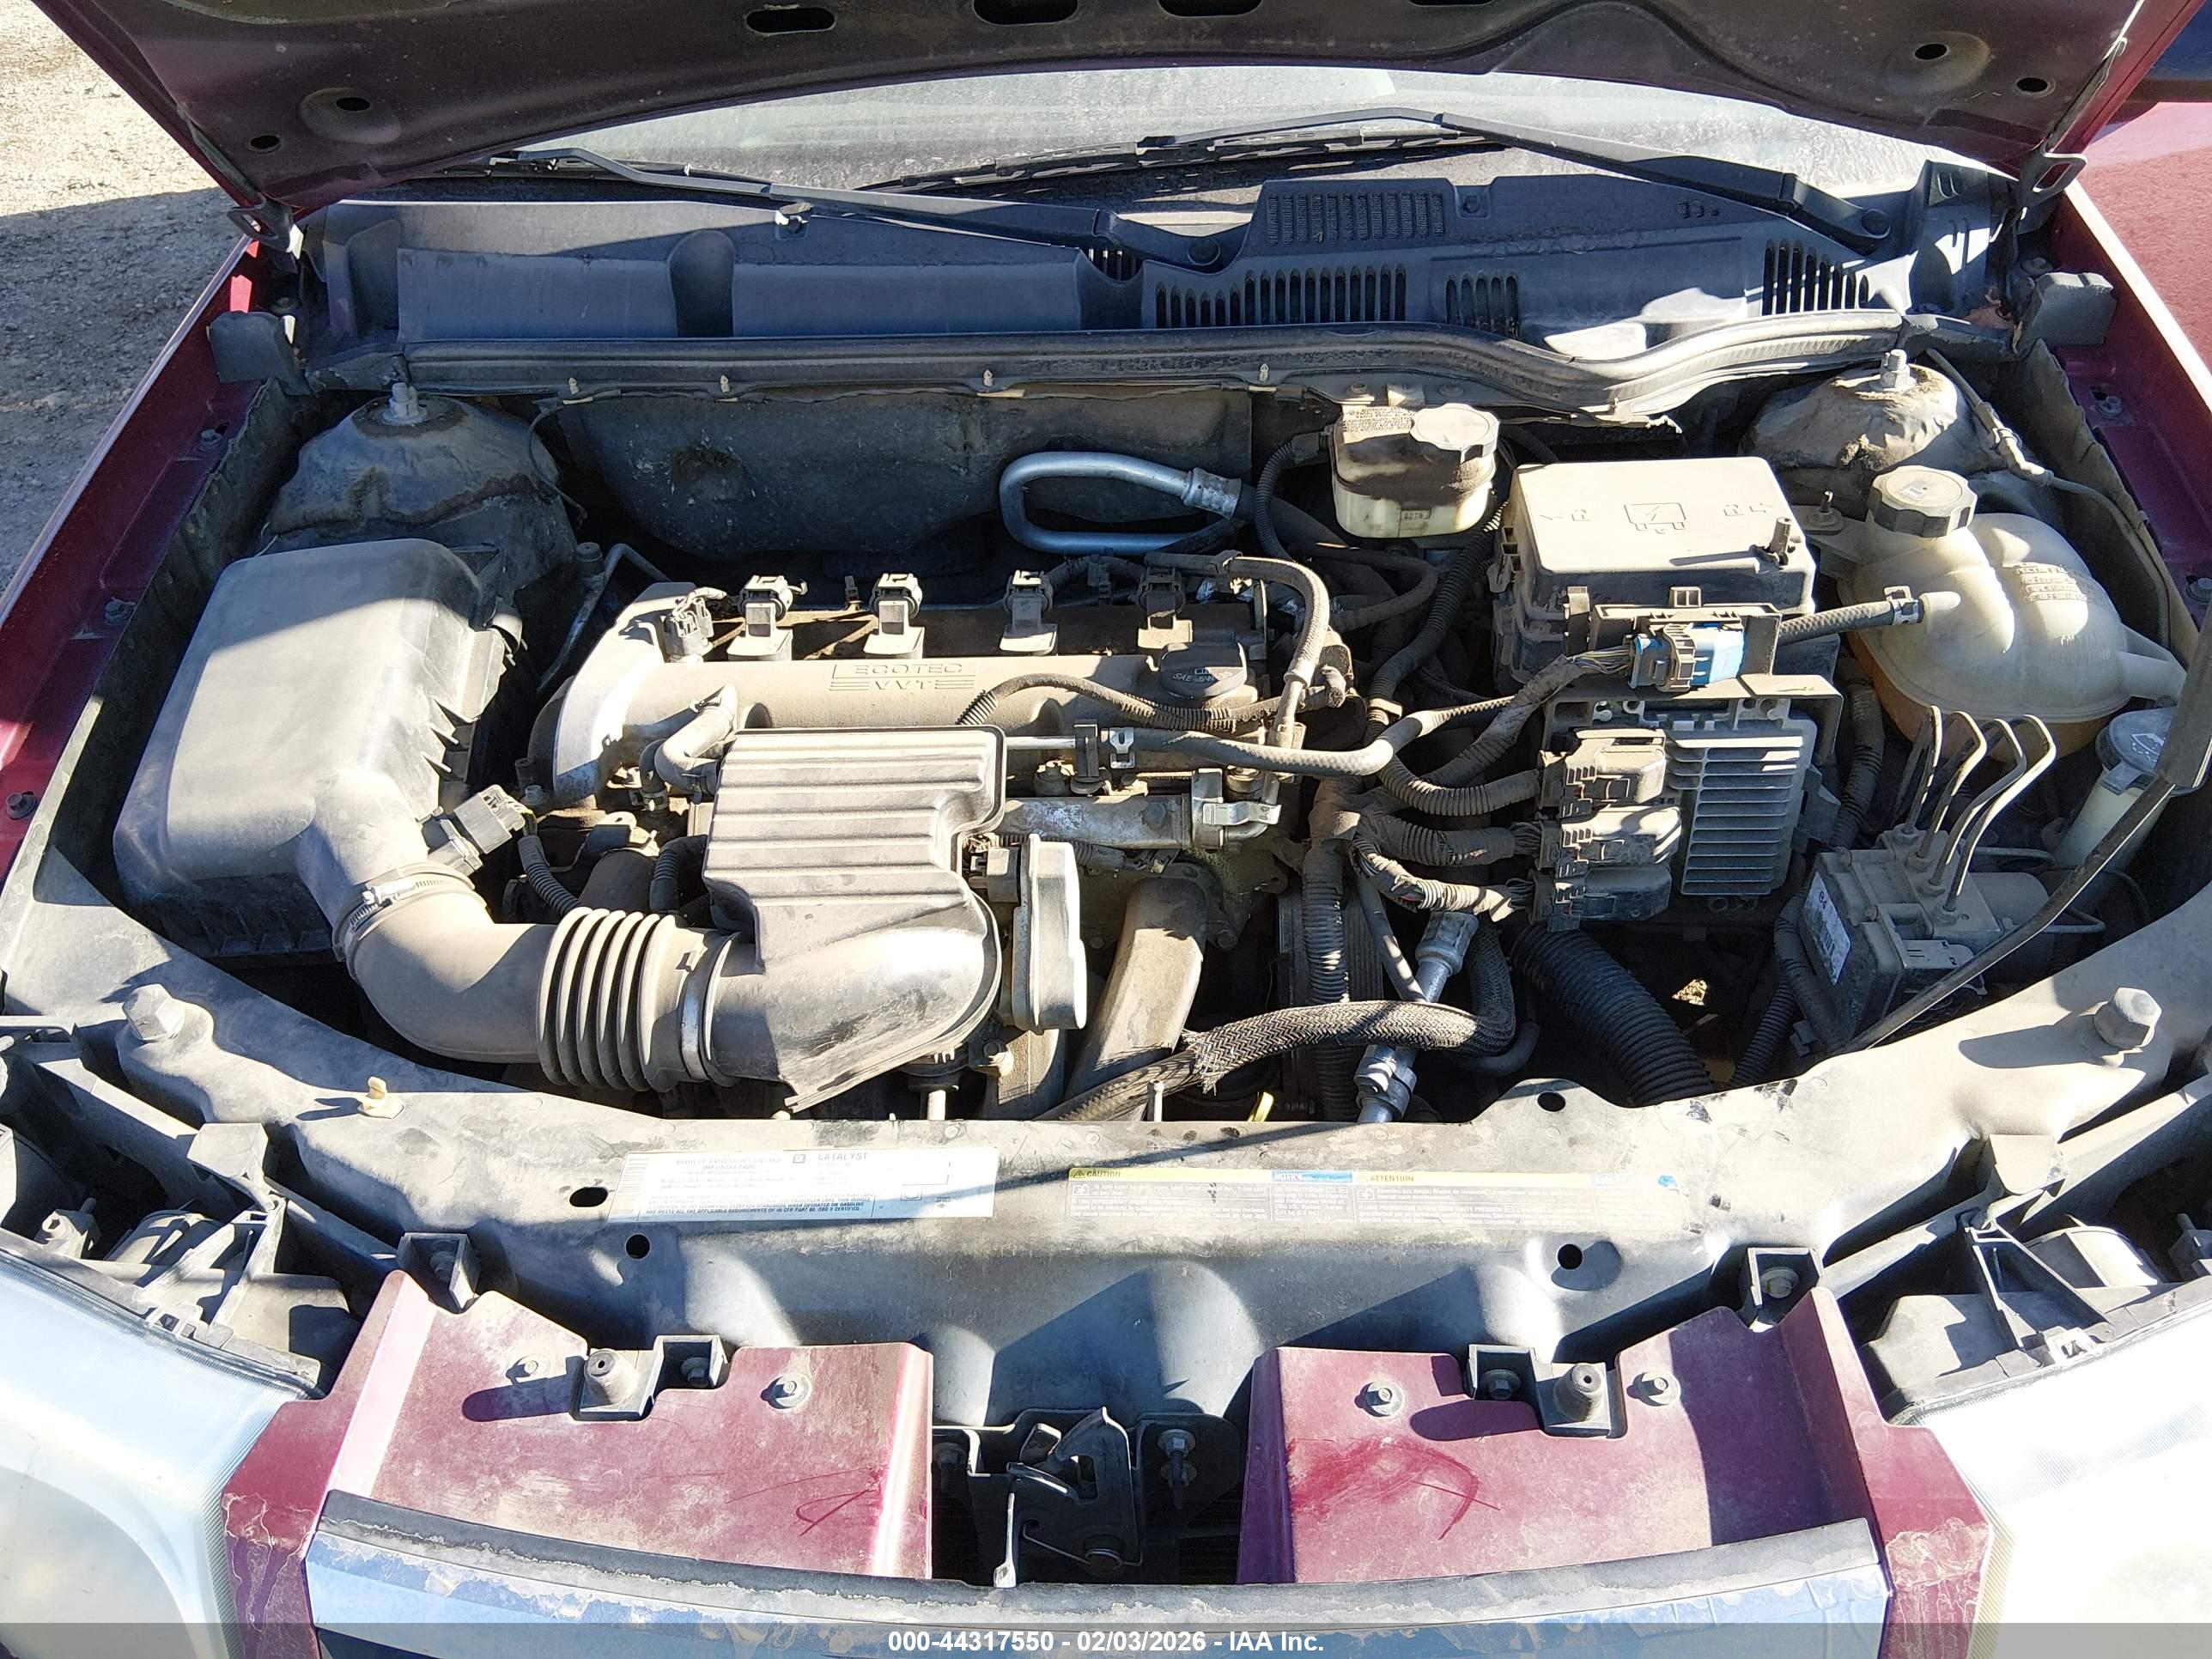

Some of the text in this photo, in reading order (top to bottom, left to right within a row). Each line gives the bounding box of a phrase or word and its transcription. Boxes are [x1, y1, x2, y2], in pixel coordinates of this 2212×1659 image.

[853, 663, 963, 676] ECOTEC
[1172, 672, 1194, 682] SAE
[874, 679, 933, 691] VVT
[1086, 1170, 1121, 1178] CAUTION
